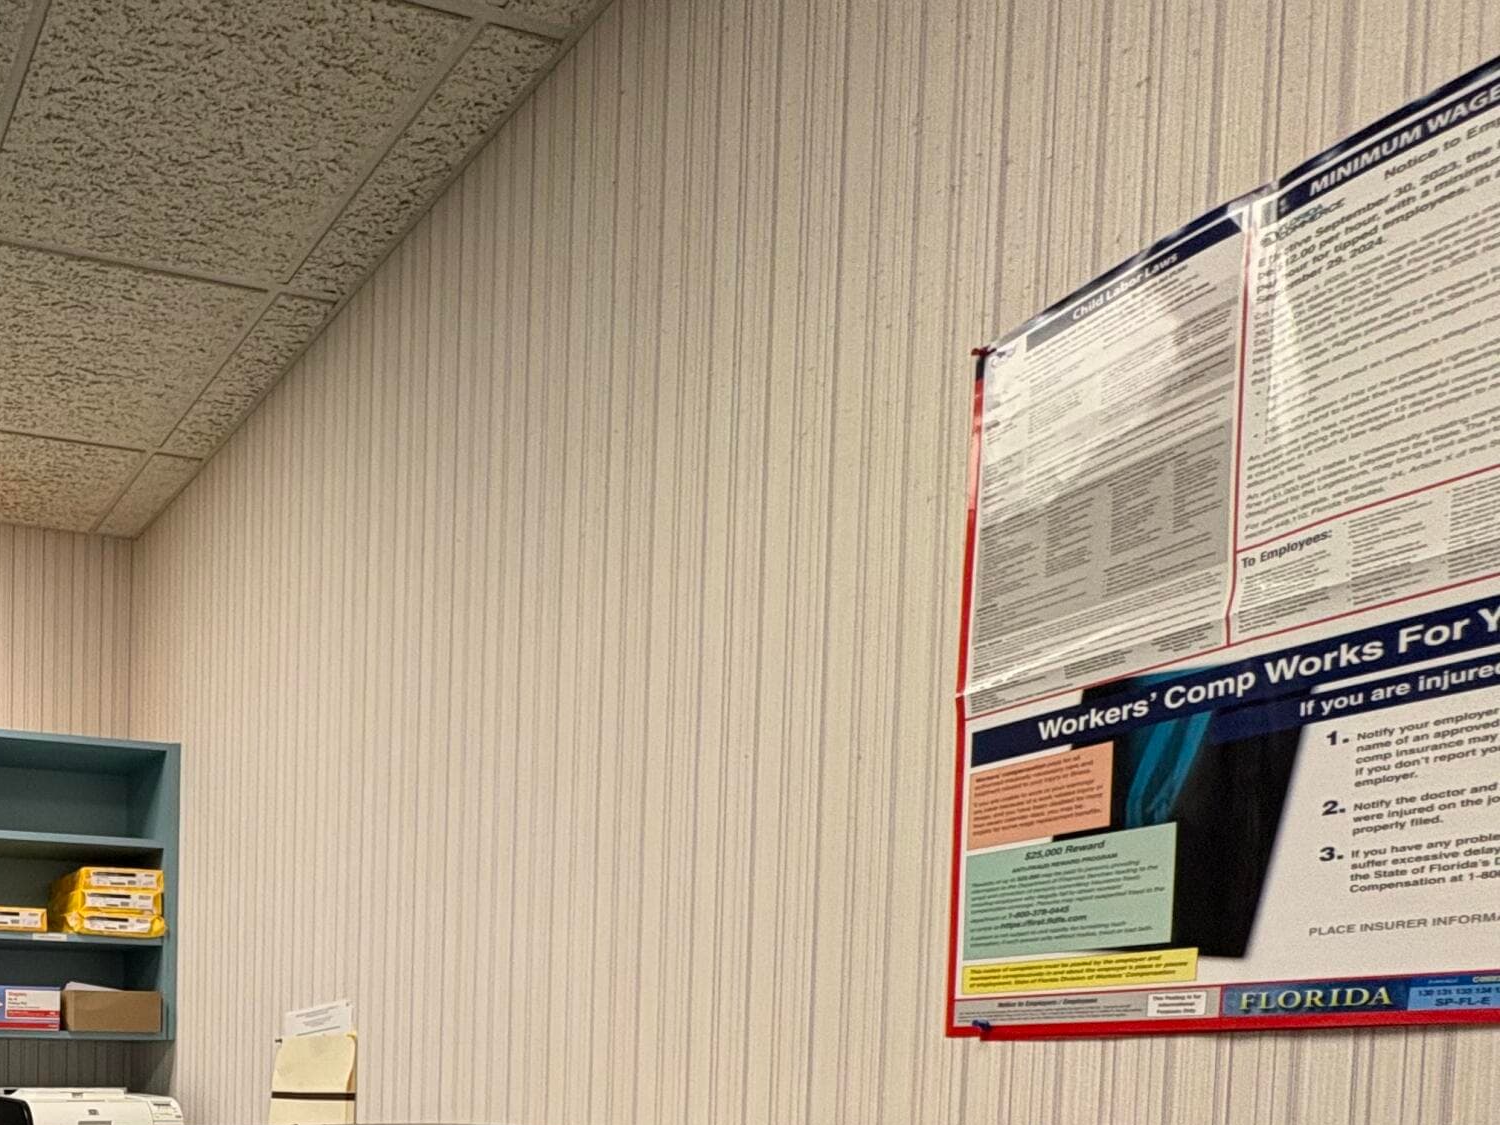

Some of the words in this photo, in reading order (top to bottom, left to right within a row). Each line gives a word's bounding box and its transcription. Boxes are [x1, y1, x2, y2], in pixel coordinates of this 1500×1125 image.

[1309, 125, 1422, 196] MINIMUM
[1384, 148, 1438, 180] Notice
[1443, 137, 1461, 151] to
[1315, 194, 1390, 237] September
[1466, 146, 1493, 163] the
[1319, 231, 1340, 250] per
[1384, 196, 1416, 215] with
[1312, 250, 1330, 263] for
[1334, 225, 1378, 252] tipped
[1072, 294, 1105, 321] Child
[1106, 273, 1143, 302] Labor
[1144, 254, 1179, 279] Laws
[1241, 556, 1255, 568] To
[1260, 529, 1333, 563] Employees:
[1164, 668, 1256, 709] Comp
[1264, 639, 1384, 679] Works
[1398, 618, 1471, 654] For
[1300, 700, 1318, 717] If
[1321, 690, 1364, 717] you
[1371, 680, 1411, 701] are
[1326, 730, 1350, 746] 1.
[1356, 727, 1395, 741] Notify
[1399, 721, 1430, 734] your
[1433, 707, 1500, 727] employer
[1356, 740, 1392, 753] name
[1395, 734, 1408, 746] of
[1412, 733, 1430, 743] an
[1433, 718, 1500, 740] approved
[1355, 751, 1392, 764] comp
[1396, 739, 1464, 757] insurance
[1468, 733, 1499, 745] may
[1355, 767, 1364, 777] if
[1367, 764, 1391, 776] you
[1433, 749, 1477, 763] report
[1354, 772, 1418, 788] employer.
[1322, 800, 1346, 816] 2.
[1353, 798, 1392, 812] Notify
[1395, 794, 1417, 805] the
[1420, 788, 1466, 802] doctor
[1469, 782, 1498, 794] and
[1352, 812, 1384, 823] were
[1387, 804, 1435, 818] injured
[1438, 801, 1457, 811] on
[1460, 796, 1484, 807] the
[1352, 822, 1407, 836] properly
[1410, 815, 1444, 827] filed.
[1065, 840, 1105, 853] Reward
[1318, 847, 1344, 862] 3.
[1351, 849, 1360, 859] If
[1363, 847, 1387, 858] you
[1390, 842, 1423, 853] have
[1426, 839, 1452, 850] any
[1350, 858, 1387, 870] suffer
[1391, 851, 1460, 865] excessive
[1349, 872, 1370, 882] the
[1373, 869, 1408, 879] State
[1411, 866, 1425, 875] of
[1429, 859, 1490, 873] Florida's
[1349, 876, 1446, 893] Compensation
[1450, 873, 1464, 882] at
[1308, 924, 1356, 936] PLACE
[1360, 918, 1428, 932] INSURER
[1238, 986, 1393, 1011] FLORIDA
